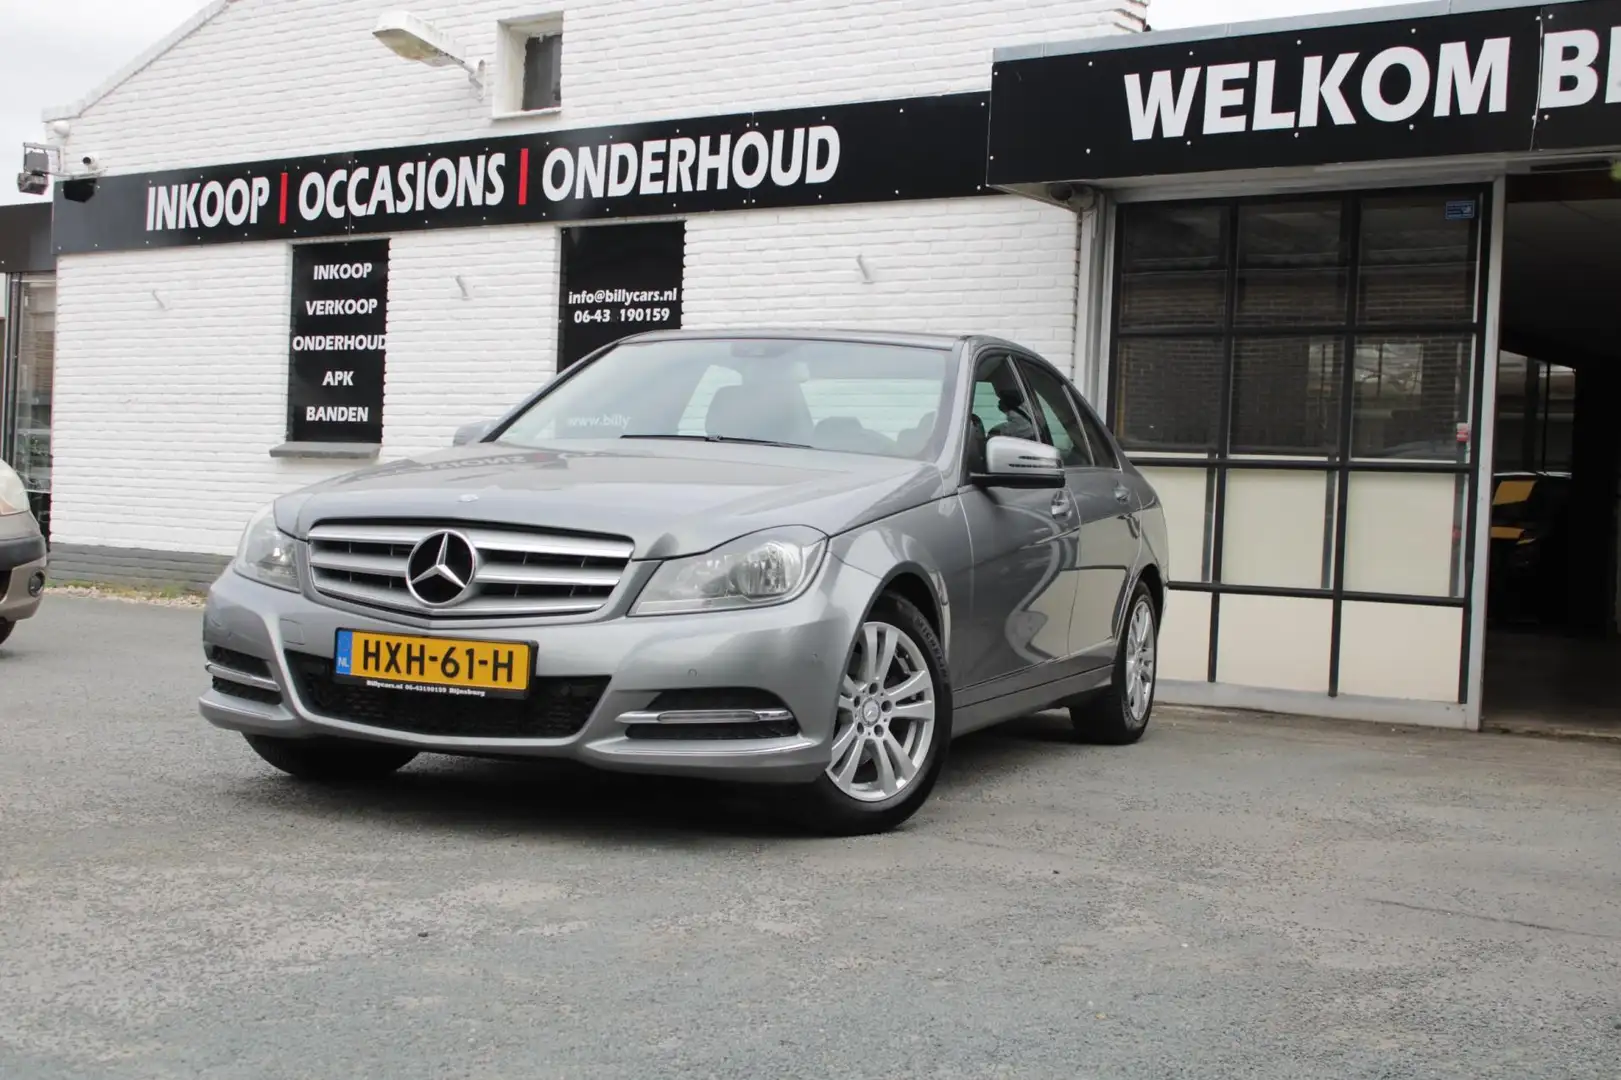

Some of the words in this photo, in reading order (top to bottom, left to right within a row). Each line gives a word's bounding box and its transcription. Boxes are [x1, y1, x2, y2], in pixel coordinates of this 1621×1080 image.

[1124, 36, 1511, 141] WELKOM
[146, 176, 270, 231] INKOOP
[299, 153, 505, 221] OCCASIONS
[542, 125, 841, 201] ONDERHOUD
[313, 263, 373, 280] INKOOP
[568, 287, 678, 306] info@billycars.nl
[305, 298, 378, 316] VERKOOP
[573, 309, 611, 324] 06-43
[619, 307, 670, 322] 190159
[292, 335, 386, 351] ONDERHOUD
[322, 371, 354, 386] APK
[306, 406, 369, 422] BANDEN
[337, 656, 350, 668] NL
[363, 639, 514, 683] HXH-61-H
